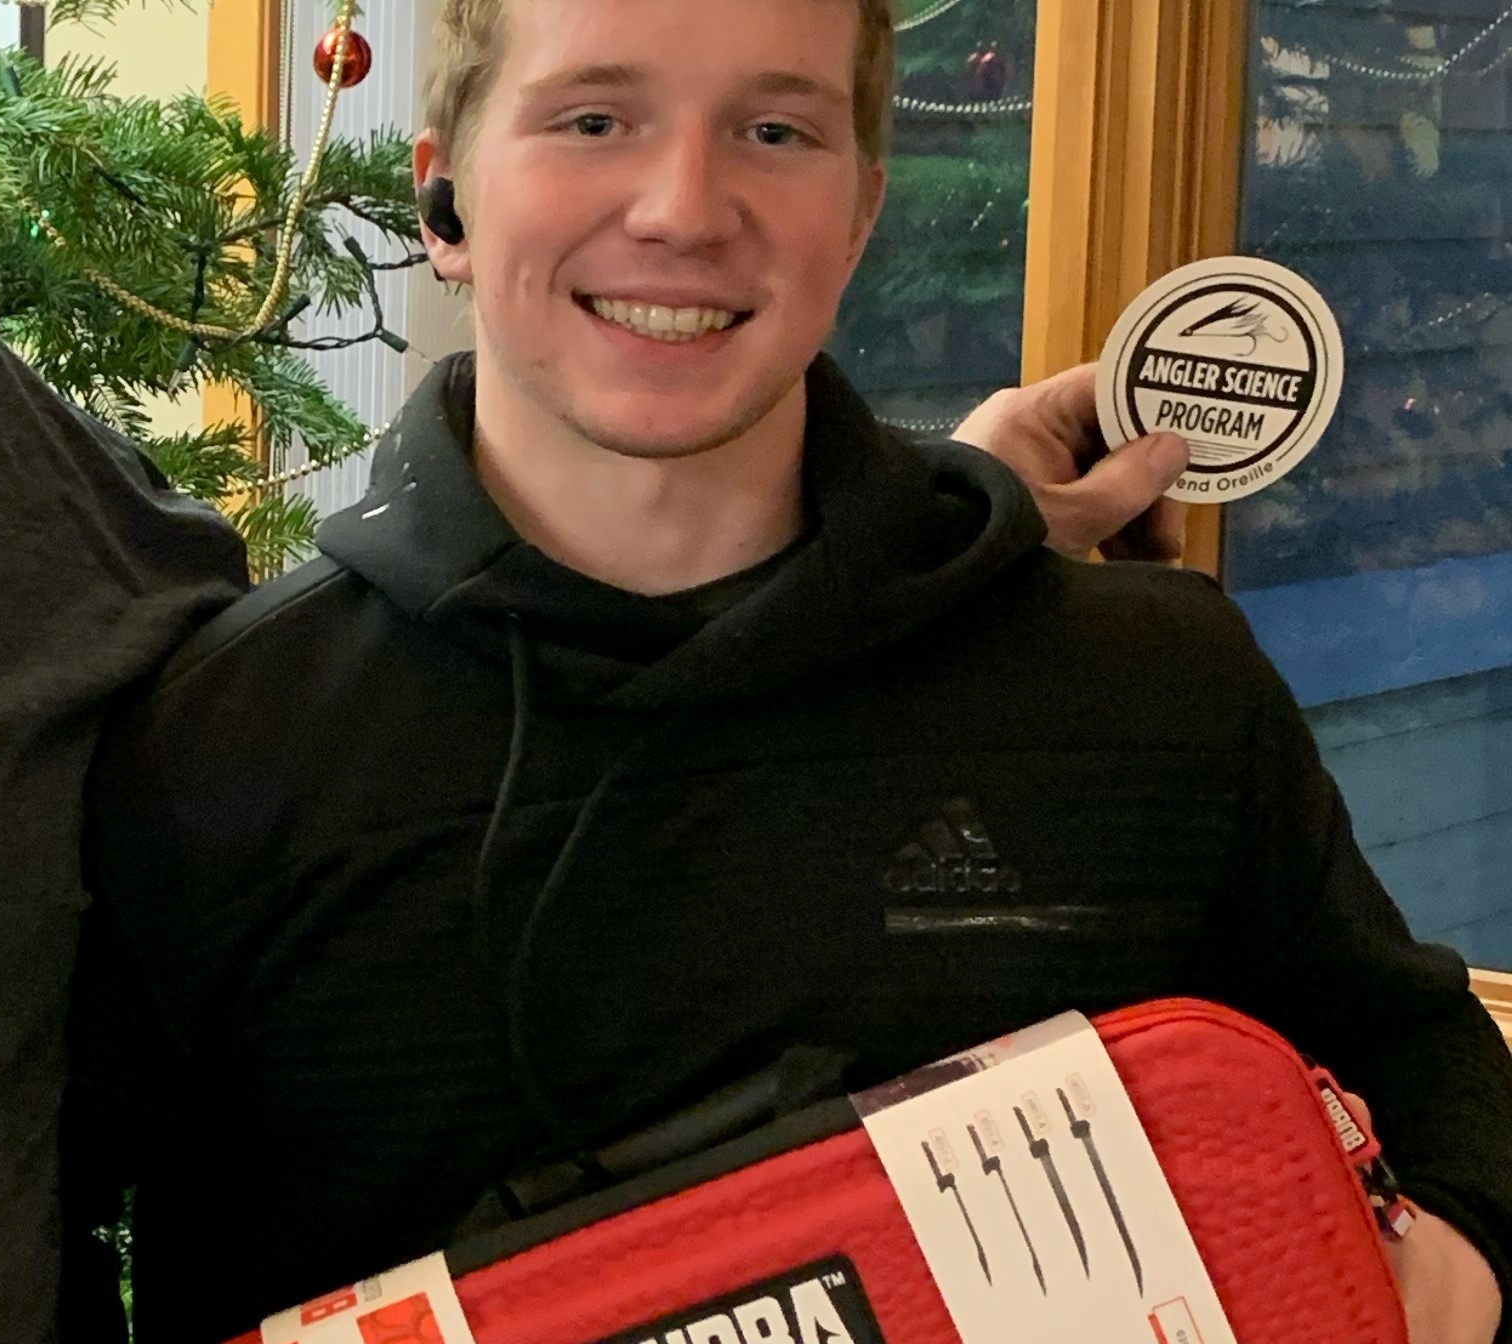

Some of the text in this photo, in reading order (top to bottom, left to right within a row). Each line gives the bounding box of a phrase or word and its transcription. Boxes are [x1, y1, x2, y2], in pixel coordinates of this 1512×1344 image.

[1140, 355, 1303, 403] ANGLER SCIENCE
[1155, 399, 1265, 441] PROGRAM
[1176, 461, 1274, 492] end Oreille
